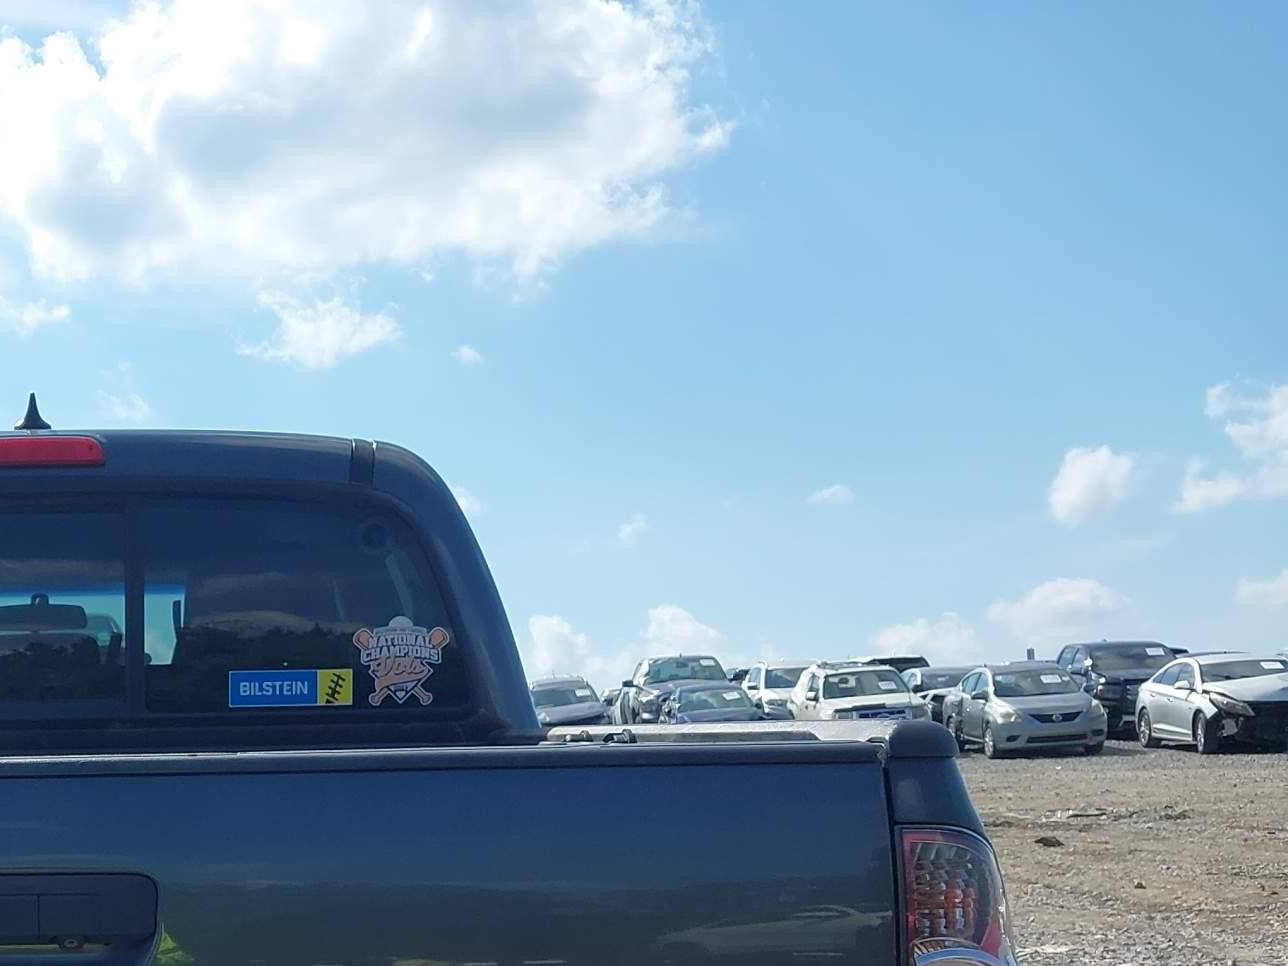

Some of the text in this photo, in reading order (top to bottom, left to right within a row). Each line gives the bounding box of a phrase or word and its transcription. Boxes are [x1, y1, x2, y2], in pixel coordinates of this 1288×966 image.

[369, 634, 433, 649] NATIONAL
[363, 645, 438, 661] CHAMPIONS
[239, 680, 308, 696] BILSTEIN
